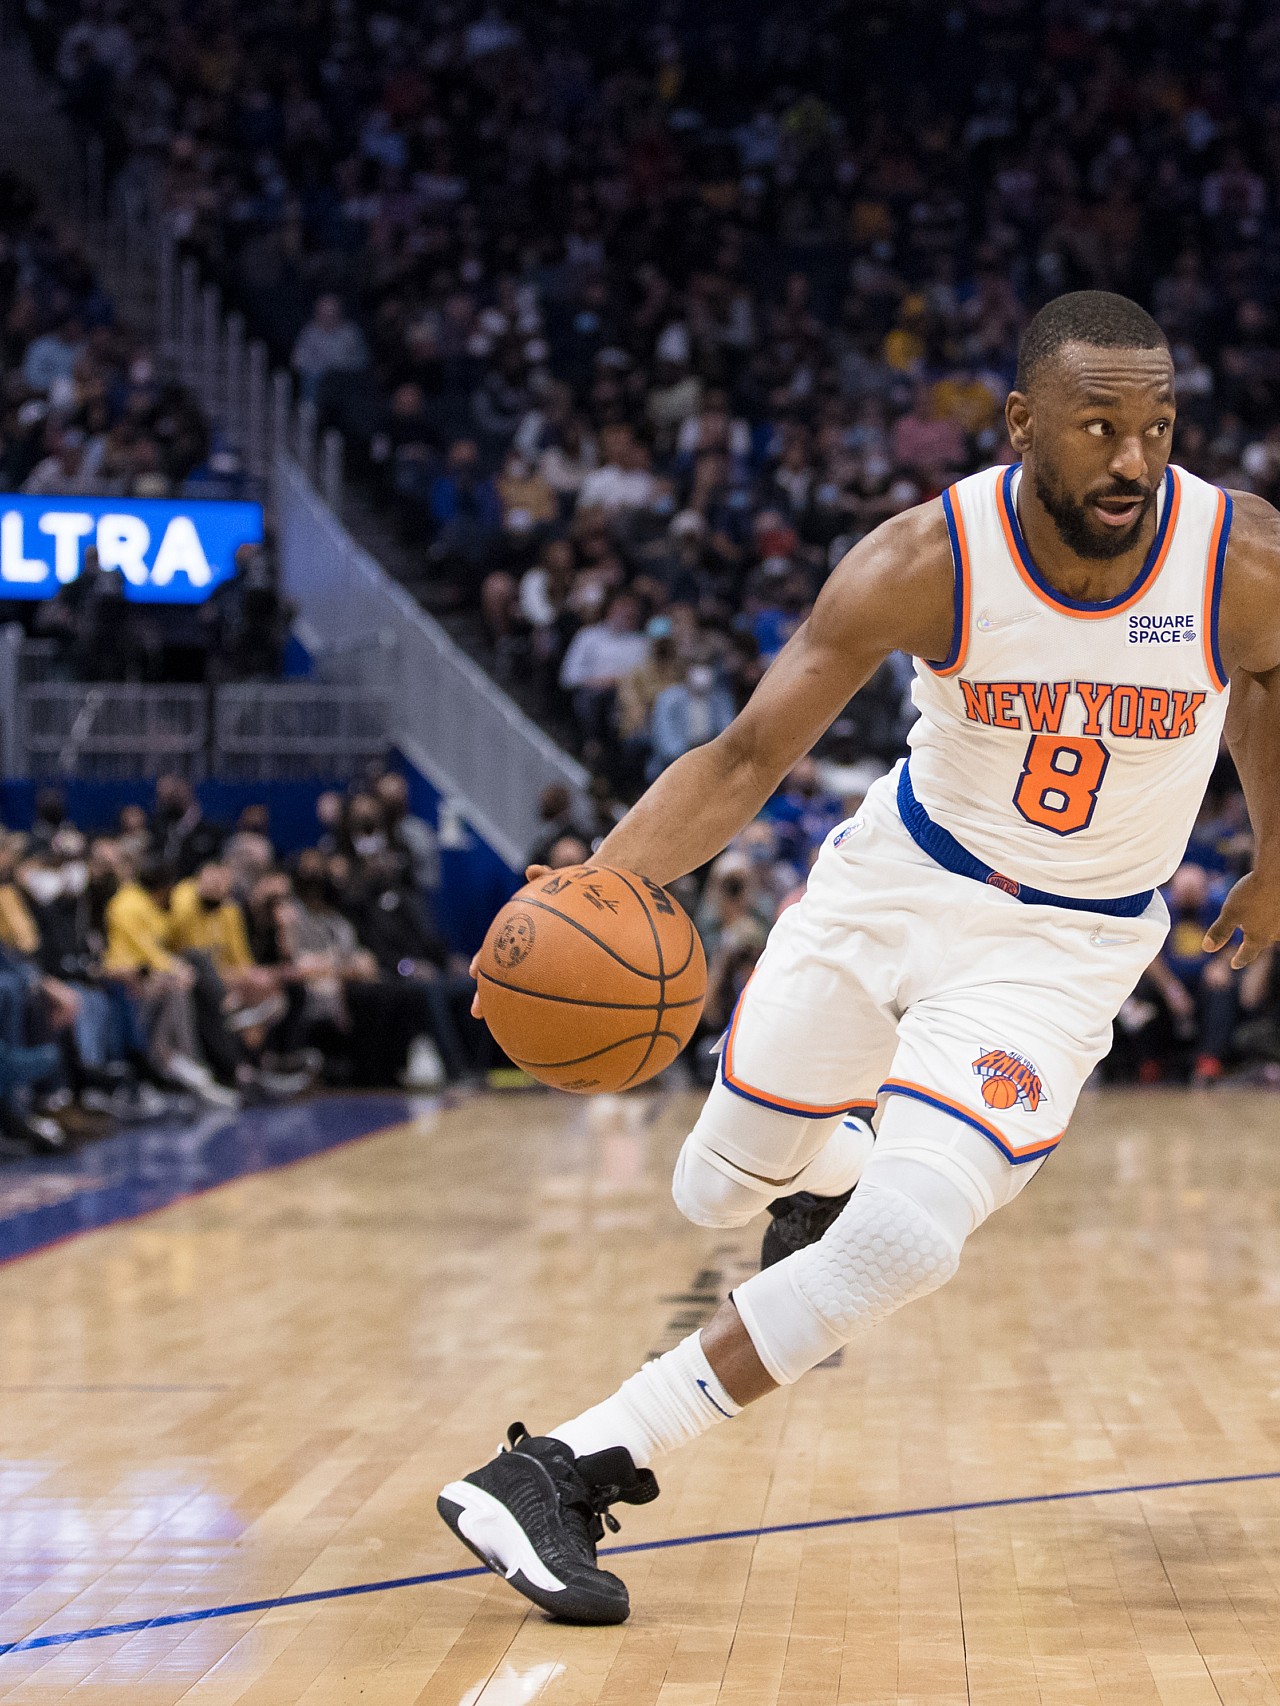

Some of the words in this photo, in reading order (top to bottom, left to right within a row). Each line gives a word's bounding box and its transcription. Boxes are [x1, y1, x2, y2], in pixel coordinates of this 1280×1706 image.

[1128, 615, 1194, 629] SQUARE
[1128, 630, 1181, 643] SPACE
[958, 678, 1072, 734] NEW
[1074, 680, 1207, 740] YORK
[1012, 734, 1111, 837] 8
[972, 1049, 1042, 1111] KNICKS
[1023, 1058, 1038, 1075] YORK
